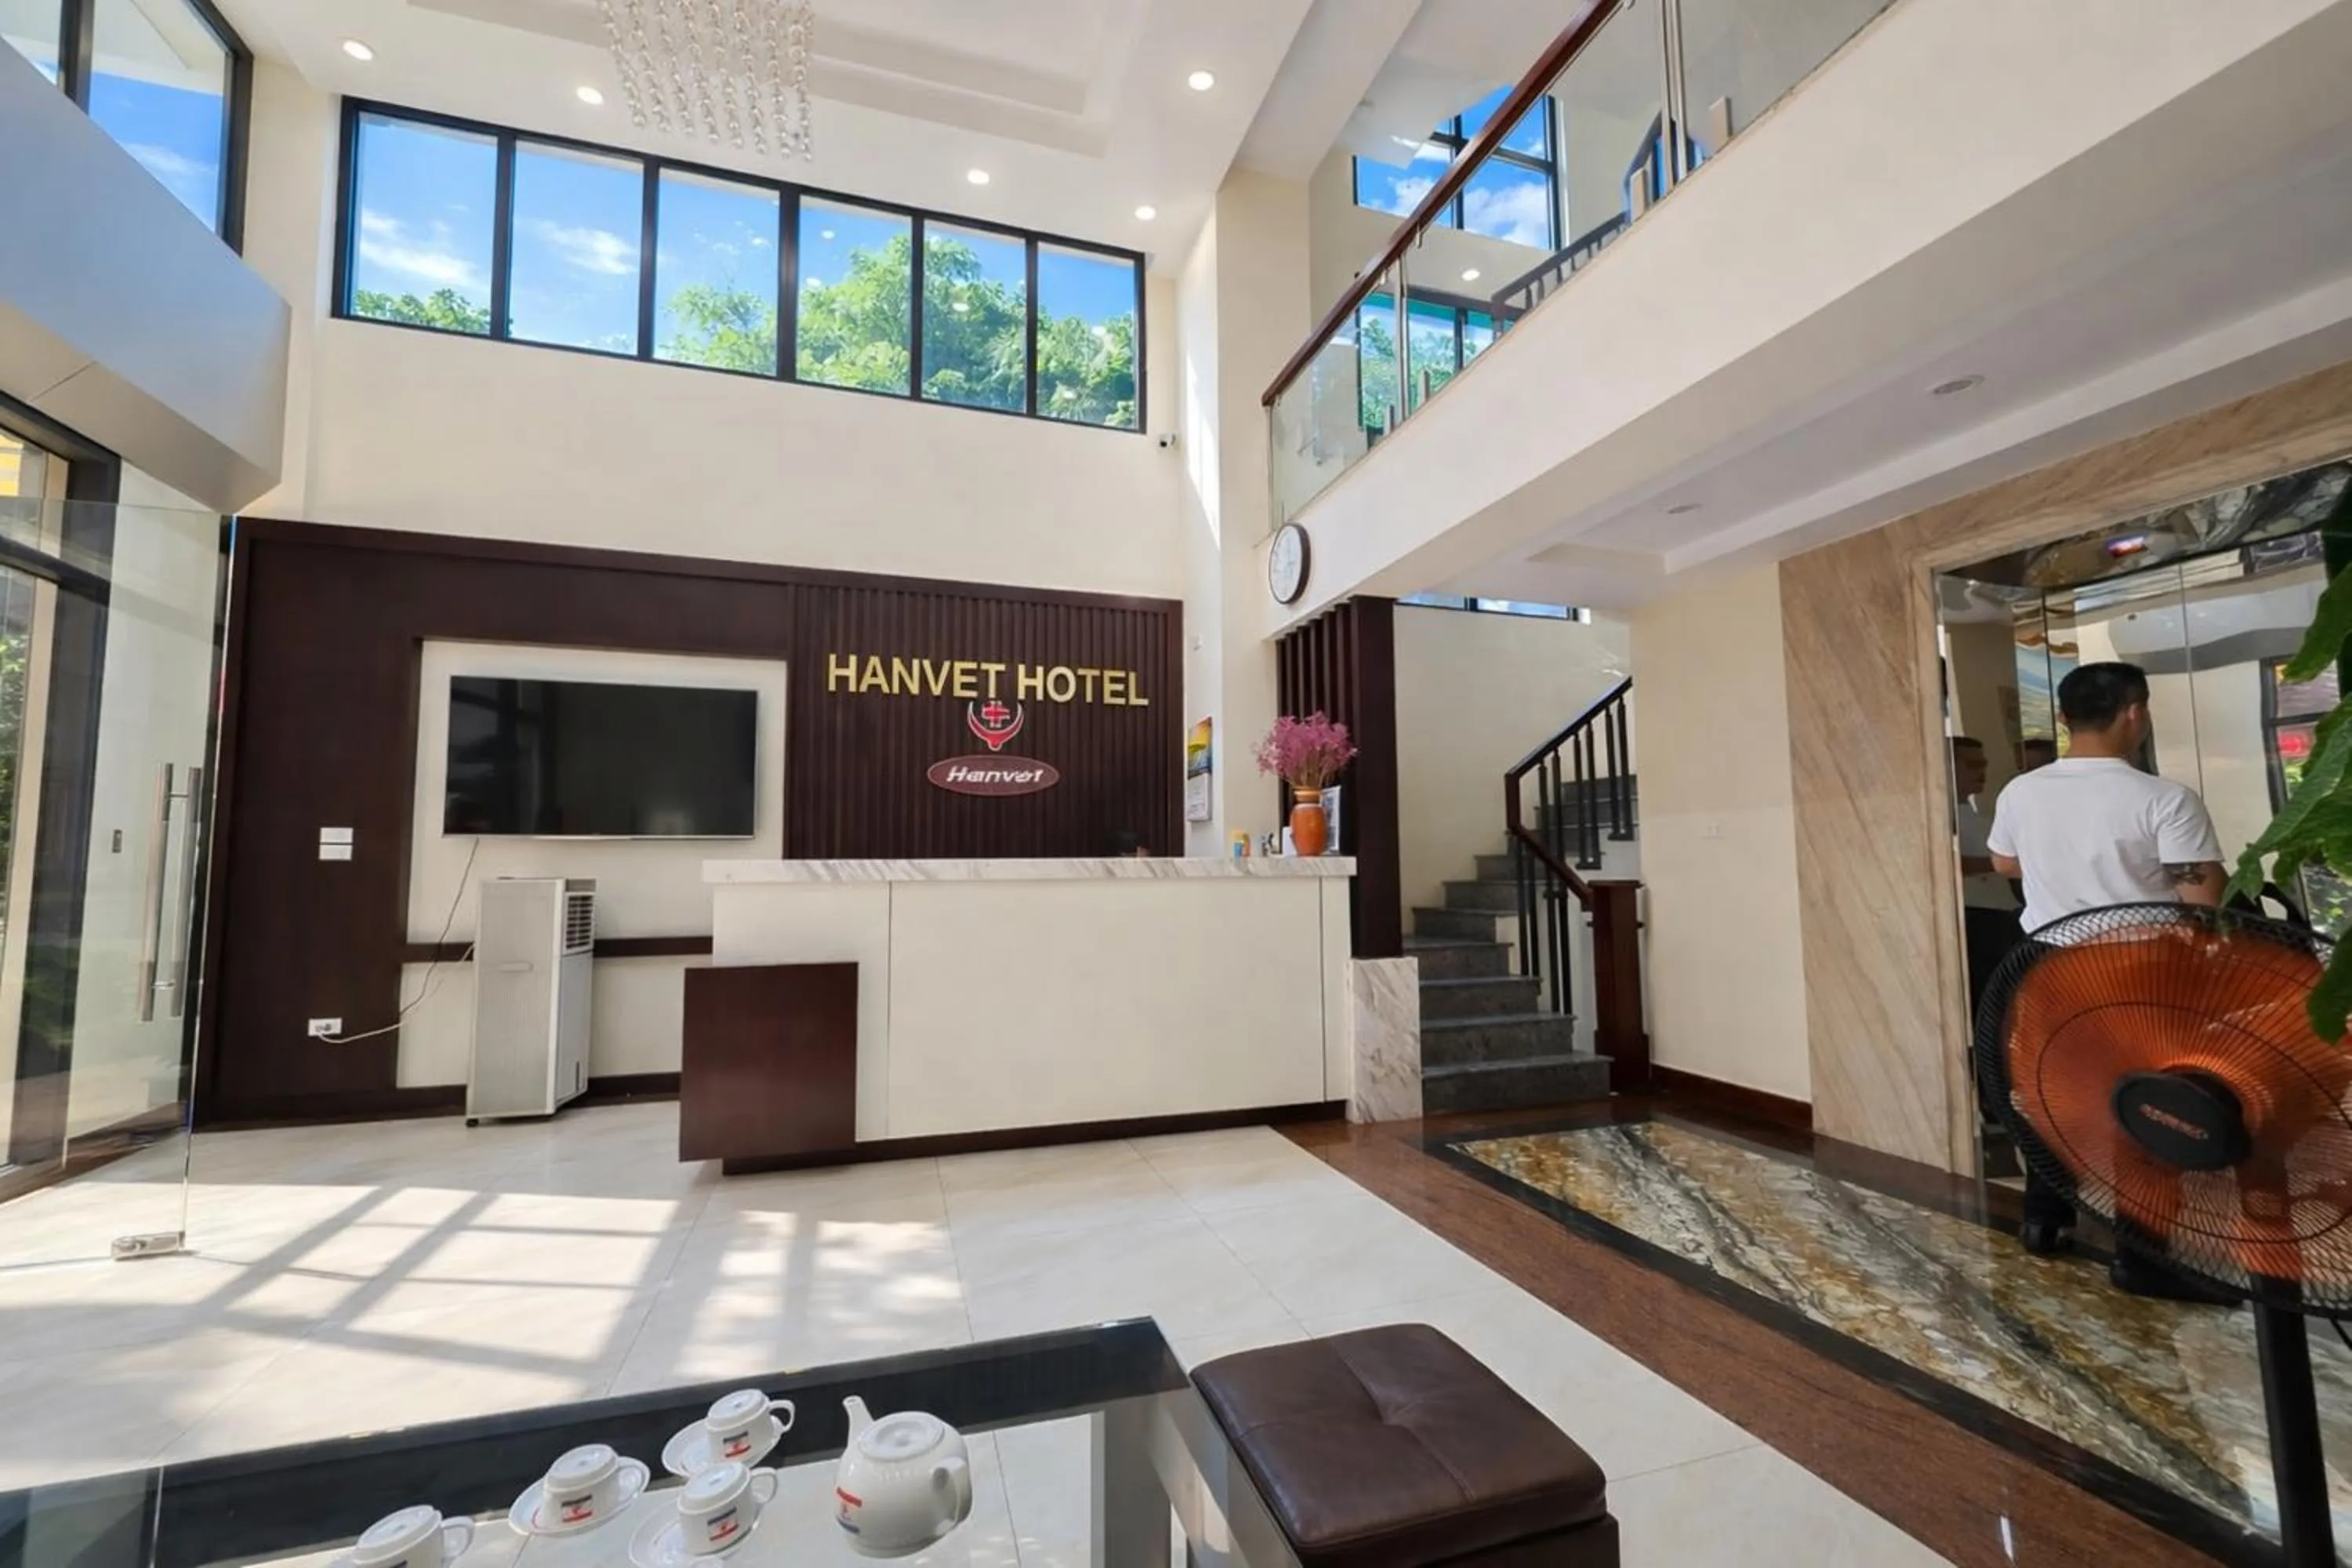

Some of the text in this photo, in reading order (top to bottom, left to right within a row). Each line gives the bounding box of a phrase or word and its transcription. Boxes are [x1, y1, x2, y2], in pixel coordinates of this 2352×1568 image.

[827, 653, 1149, 706] HANVET HOTEL
[946, 765, 1044, 783] Hanvet
